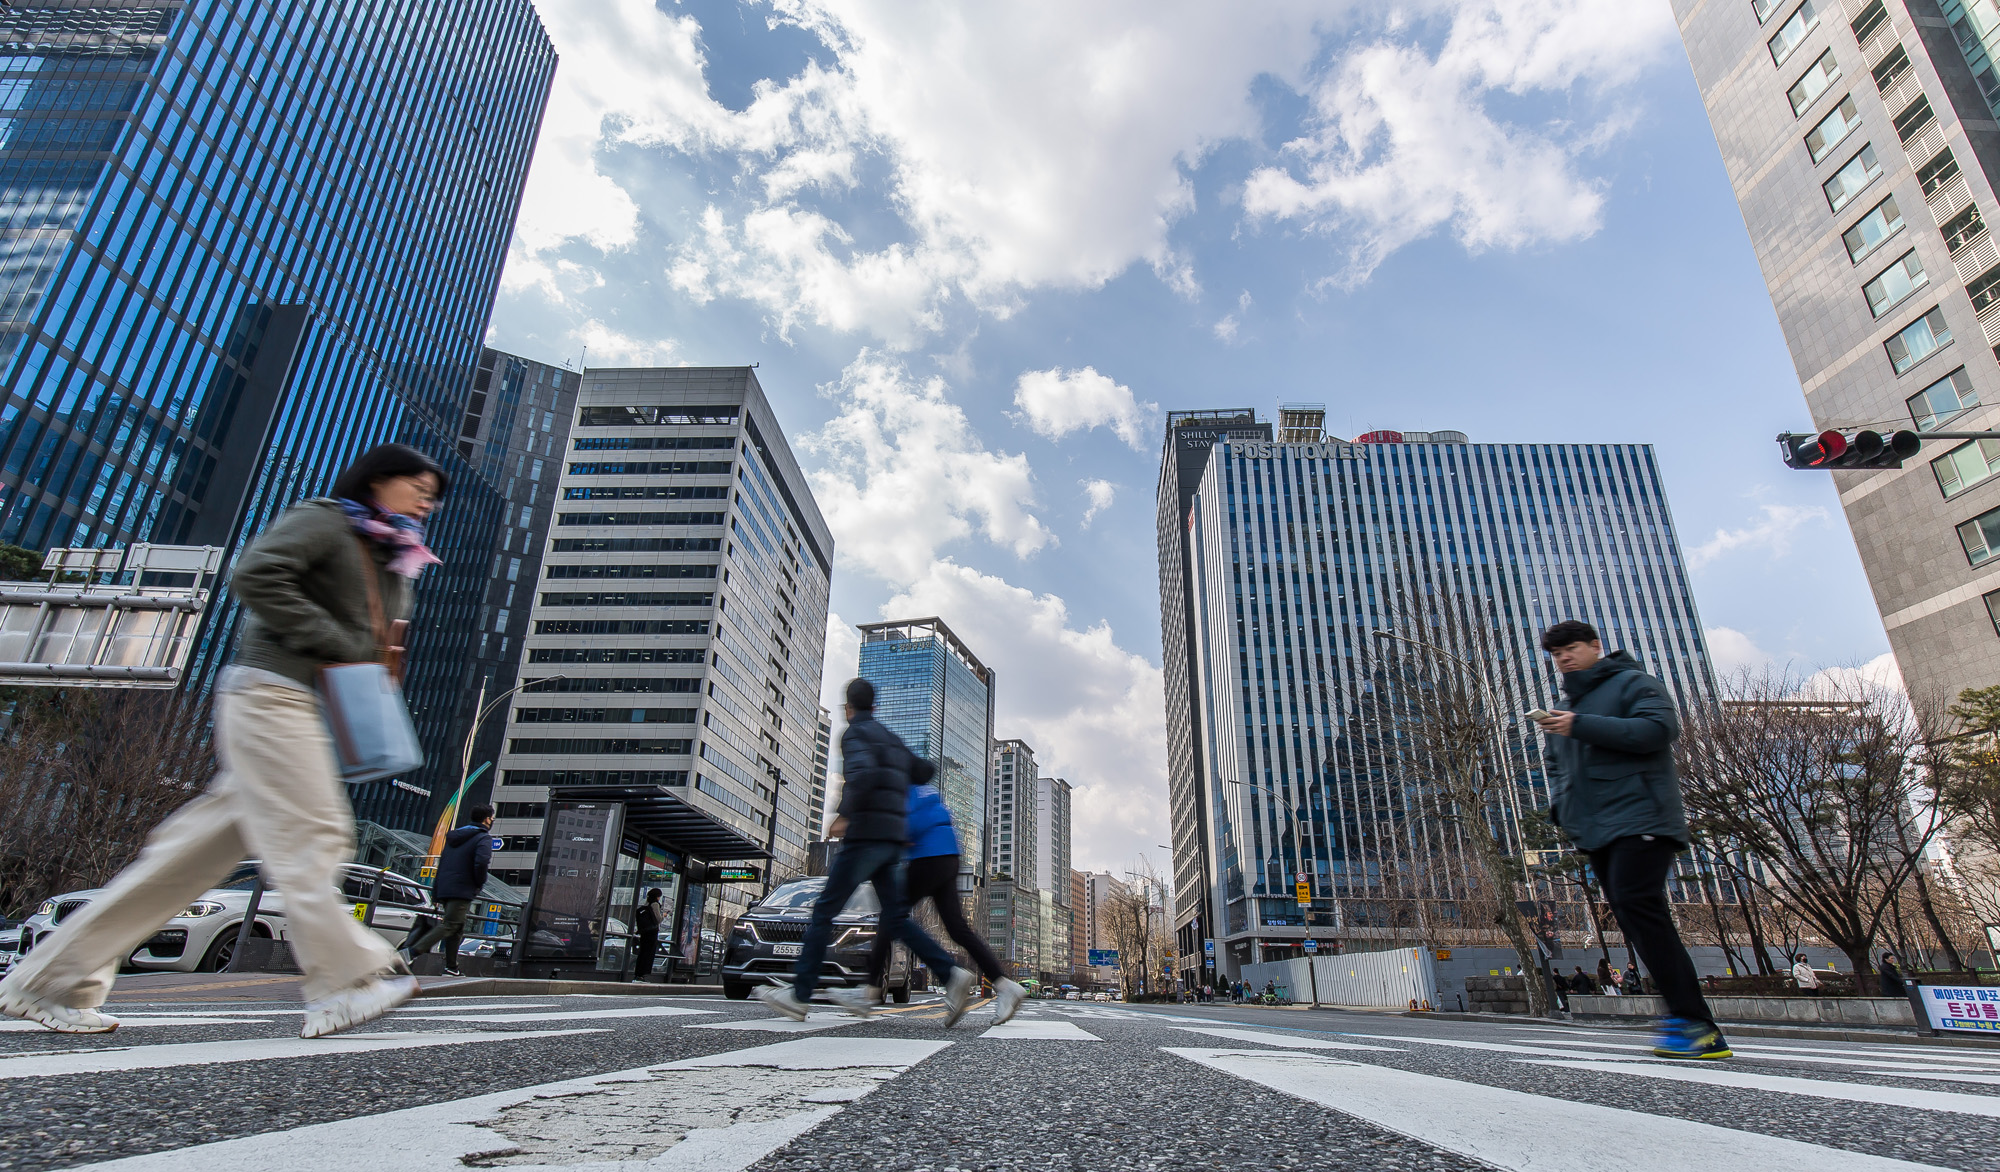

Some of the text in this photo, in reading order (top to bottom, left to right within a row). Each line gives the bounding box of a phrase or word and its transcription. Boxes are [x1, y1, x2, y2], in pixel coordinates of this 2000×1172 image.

[1181, 431, 1217, 439] SHILLA
[1187, 440, 1212, 449] STAY
[1231, 443, 1367, 460] POST TOWER
[1947, 1002, 1999, 1019] 트리플
